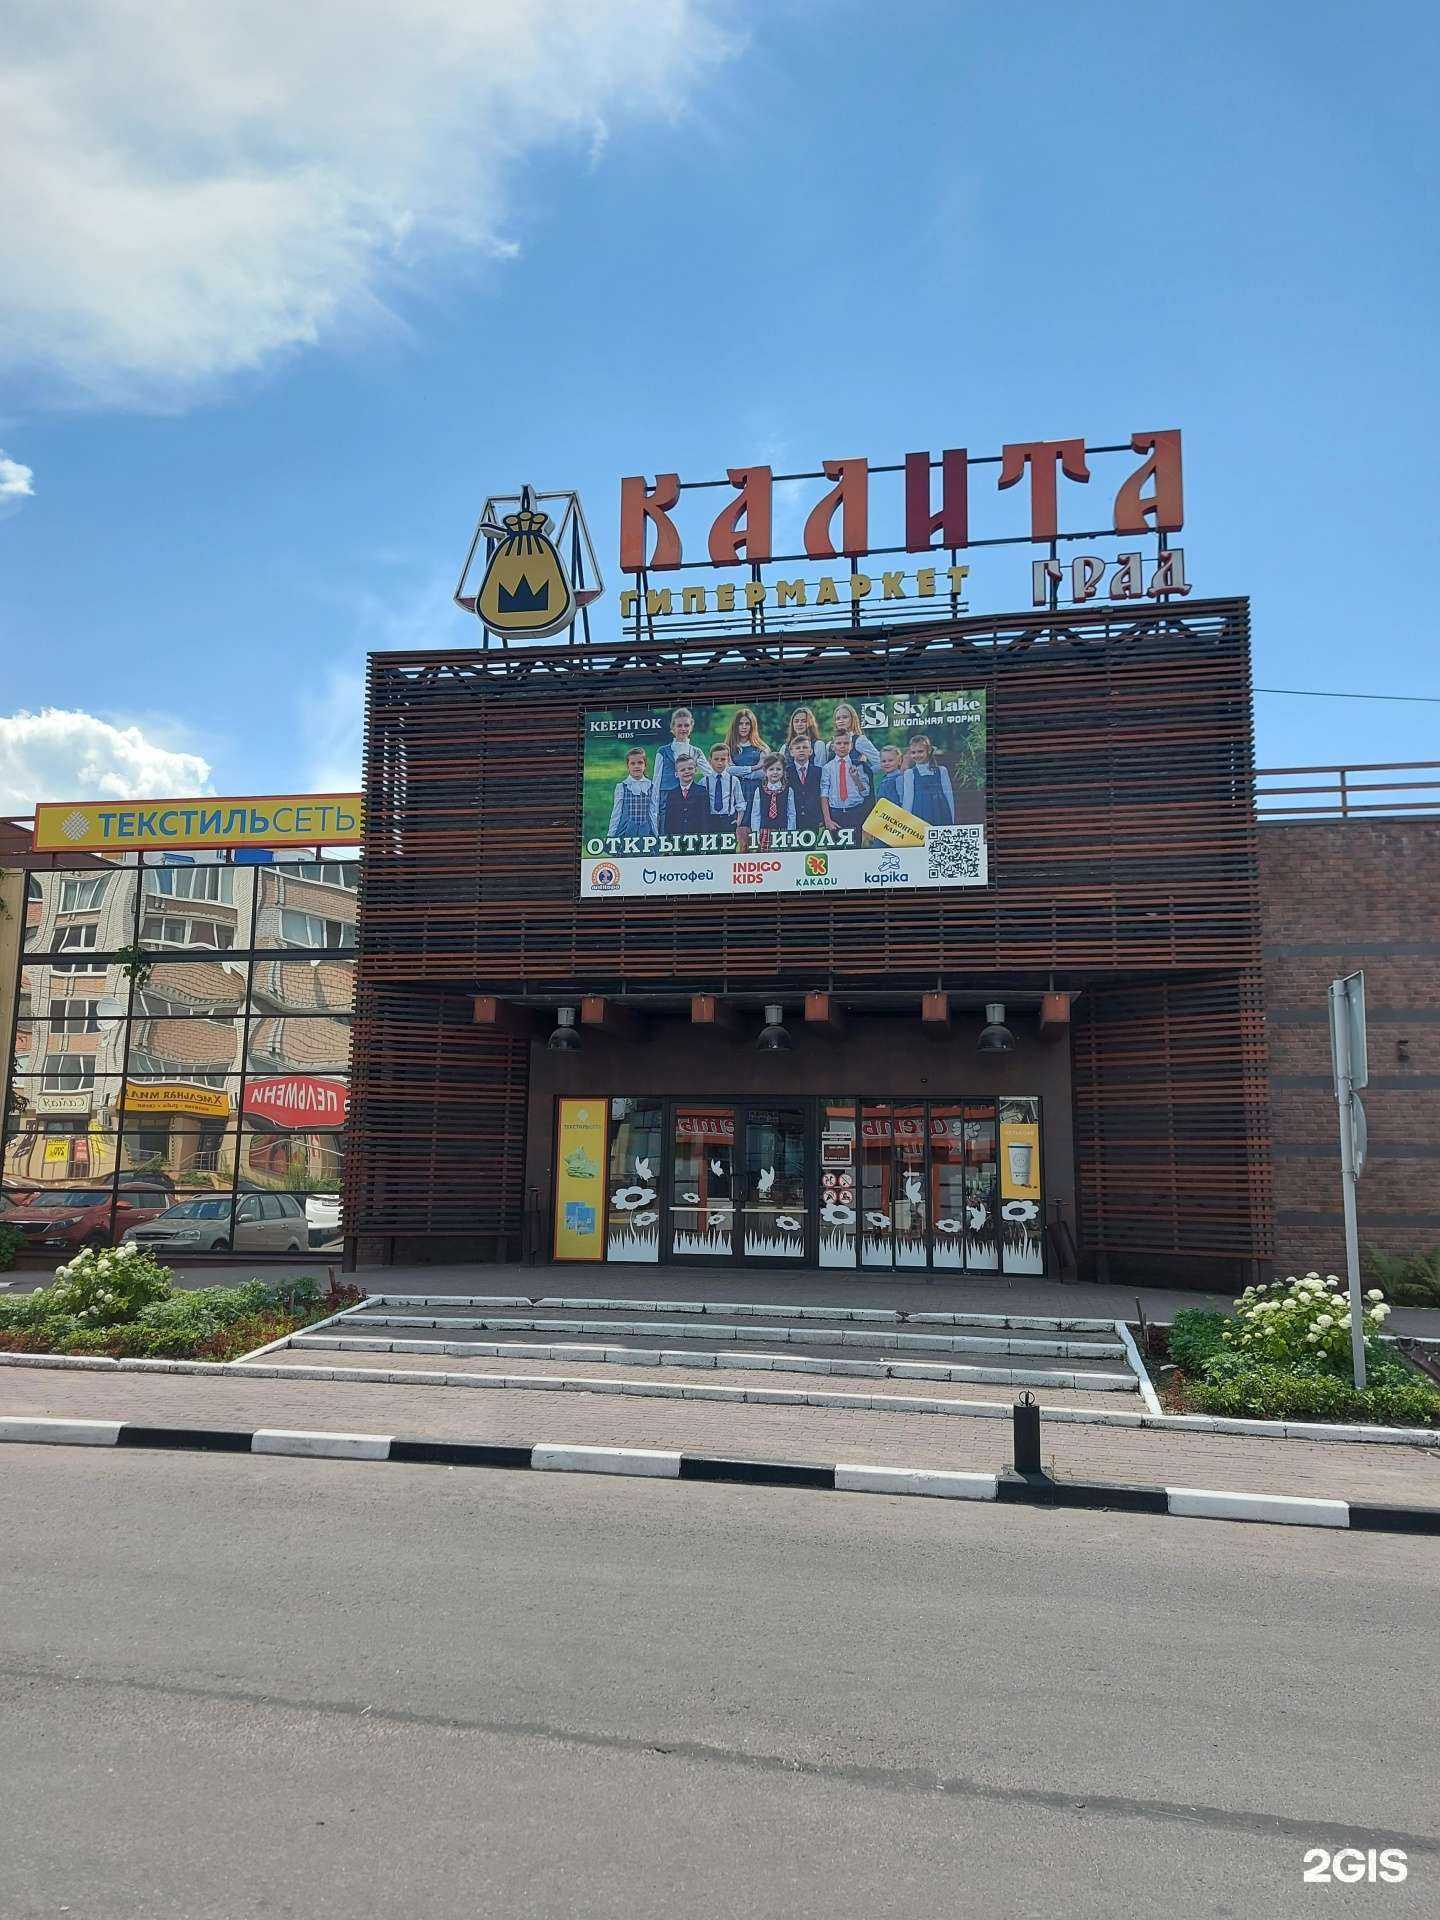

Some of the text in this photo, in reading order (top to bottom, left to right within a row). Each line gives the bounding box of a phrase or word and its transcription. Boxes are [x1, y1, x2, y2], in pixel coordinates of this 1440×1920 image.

[620, 429, 1183, 573] КАЛИТА
[1031, 549, 1192, 607] ГРАД
[620, 565, 971, 618] ГИПЕРМАРКЕТ
[893, 698, 981, 717] Sky Lake
[590, 719, 662, 732] KEEPITOK
[893, 714, 981, 727] ШКОЛЬНАЯ ФОРМА
[98, 806, 356, 838] ТЕКСТИЛЬСЕТЬ
[883, 823, 905, 840] КАРТА
[587, 828, 855, 856] ОТКРЫТИЕ 1 ИЮЛЯ
[733, 861, 782, 873] INDIGO
[659, 869, 714, 883] котофей
[733, 873, 764, 884] KIDS
[796, 877, 838, 887] KAKADU
[864, 872, 909, 886] kapika
